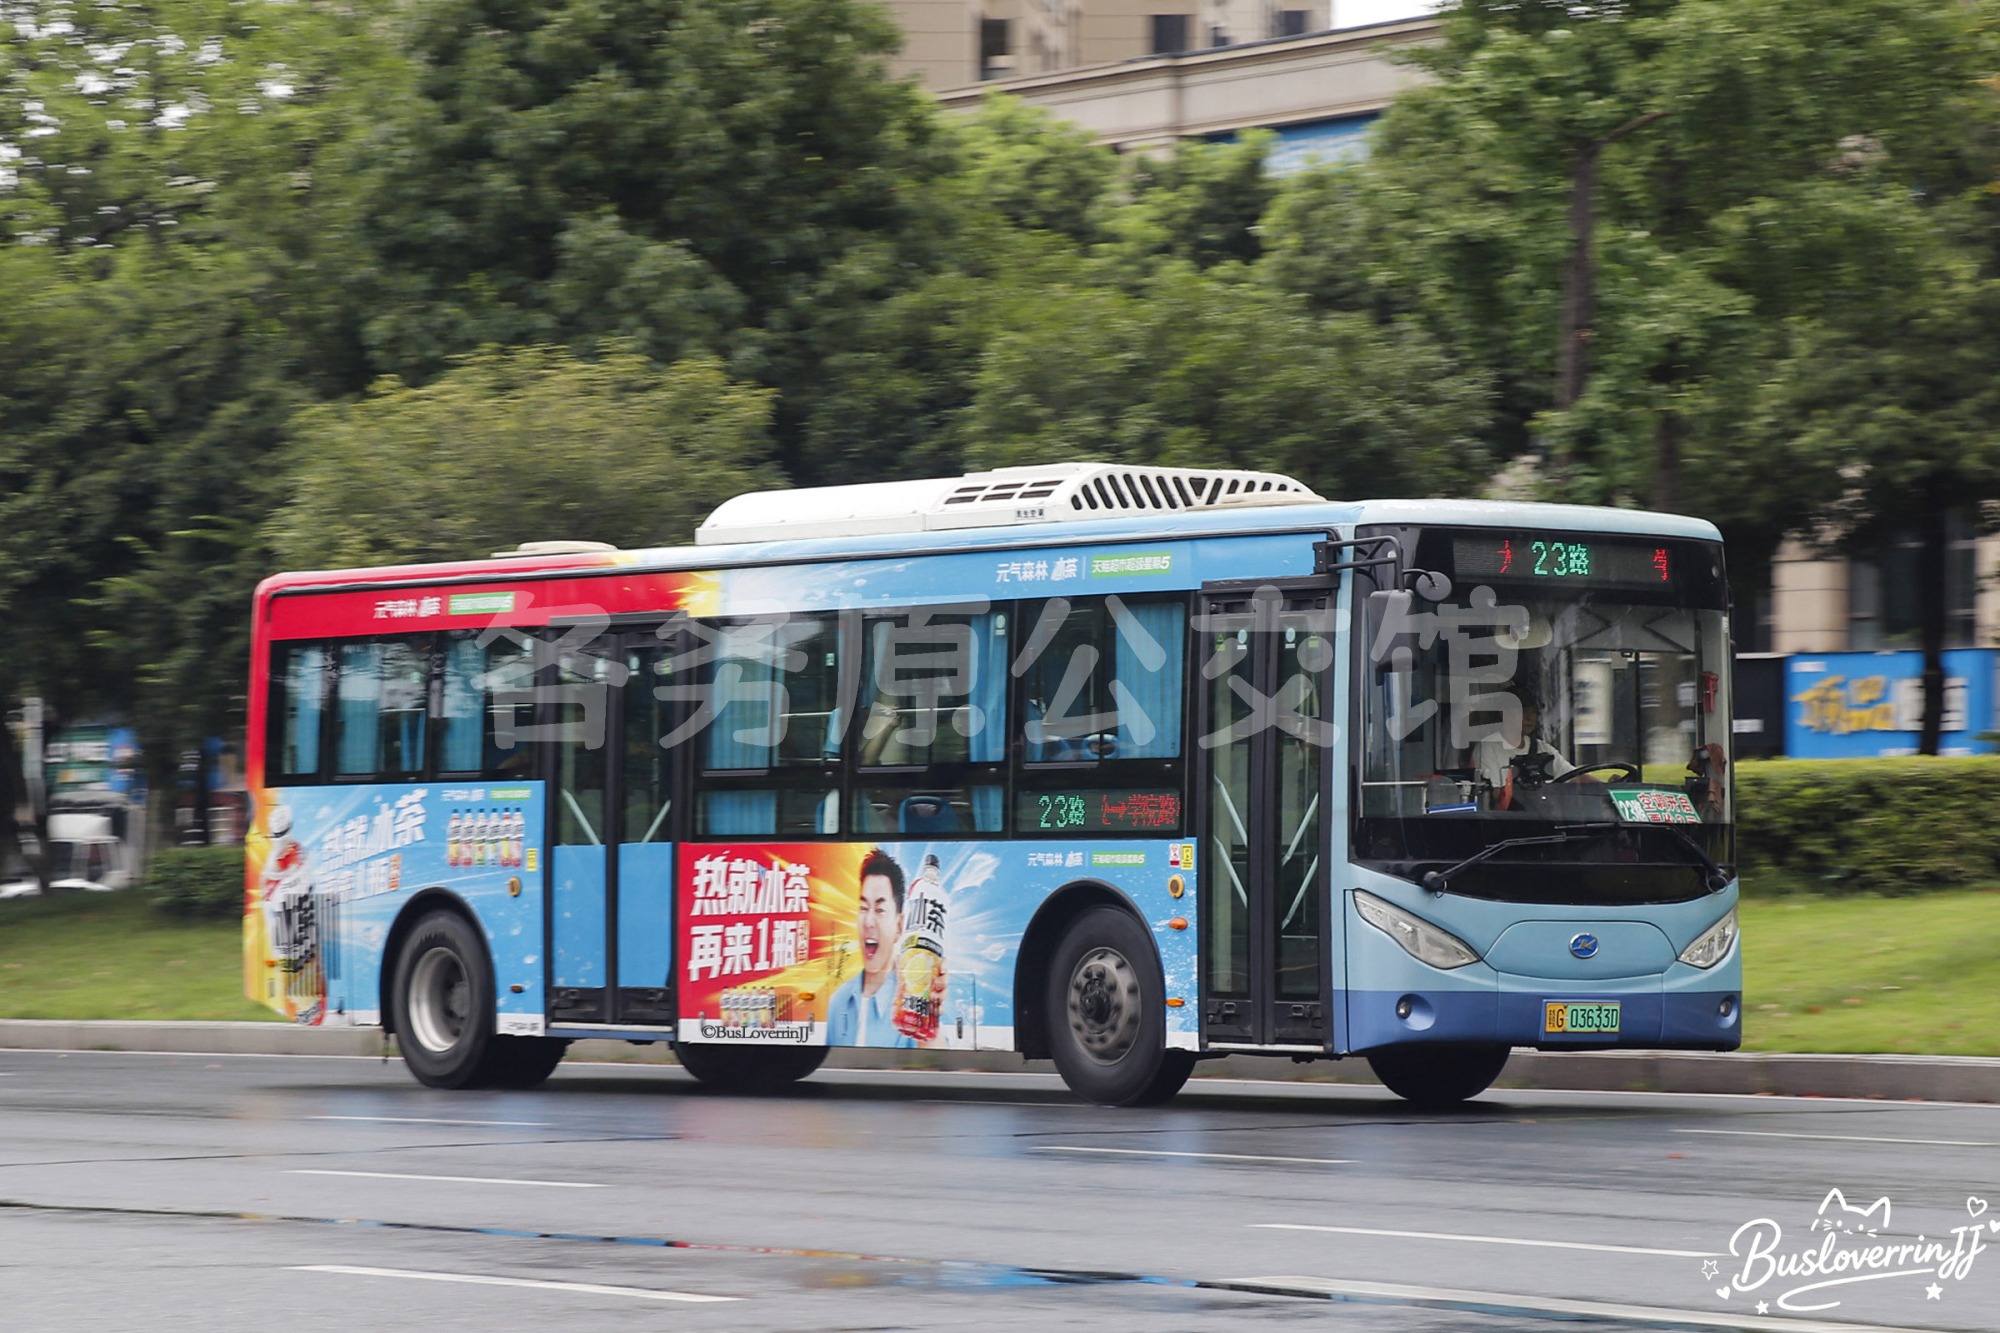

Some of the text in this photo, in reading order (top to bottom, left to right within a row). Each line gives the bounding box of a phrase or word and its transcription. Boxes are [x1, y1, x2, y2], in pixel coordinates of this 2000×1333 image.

[996, 560, 1049, 583] 元气森林
[1531, 541, 1590, 576] 23路
[1038, 795, 1086, 828] 23路
[690, 850, 811, 916] 热就冰茶
[687, 917, 798, 982] 再来1瓶
[1570, 1008, 1619, 1029] 03633D
